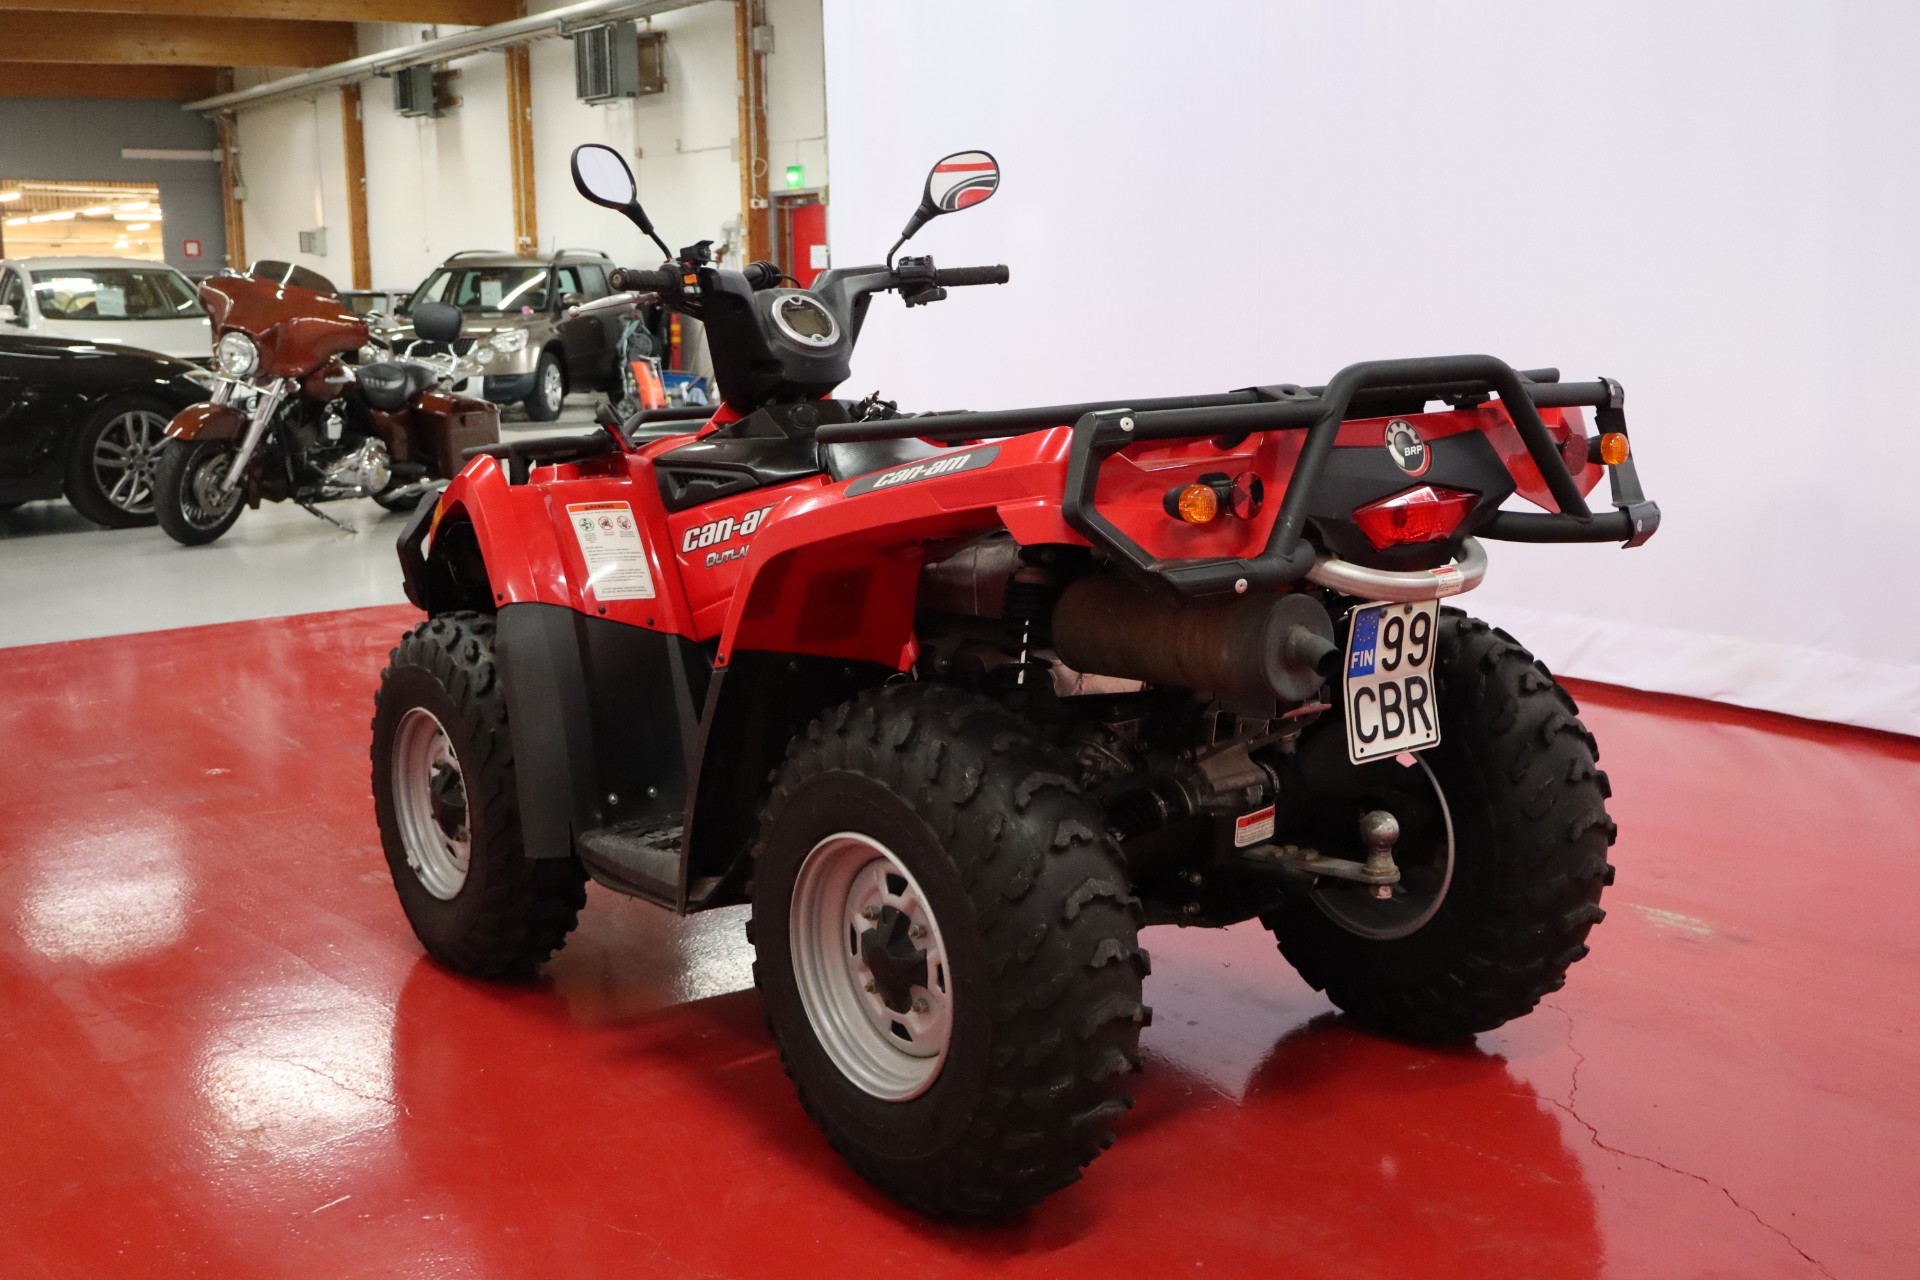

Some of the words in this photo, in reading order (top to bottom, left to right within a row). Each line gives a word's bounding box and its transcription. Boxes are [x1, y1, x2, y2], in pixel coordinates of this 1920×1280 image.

[873, 454, 971, 488] can-am
[1404, 445, 1423, 457] BRP
[1351, 648, 1374, 669] FIN
[1381, 611, 1431, 672] 99
[1354, 675, 1433, 744] CBR
